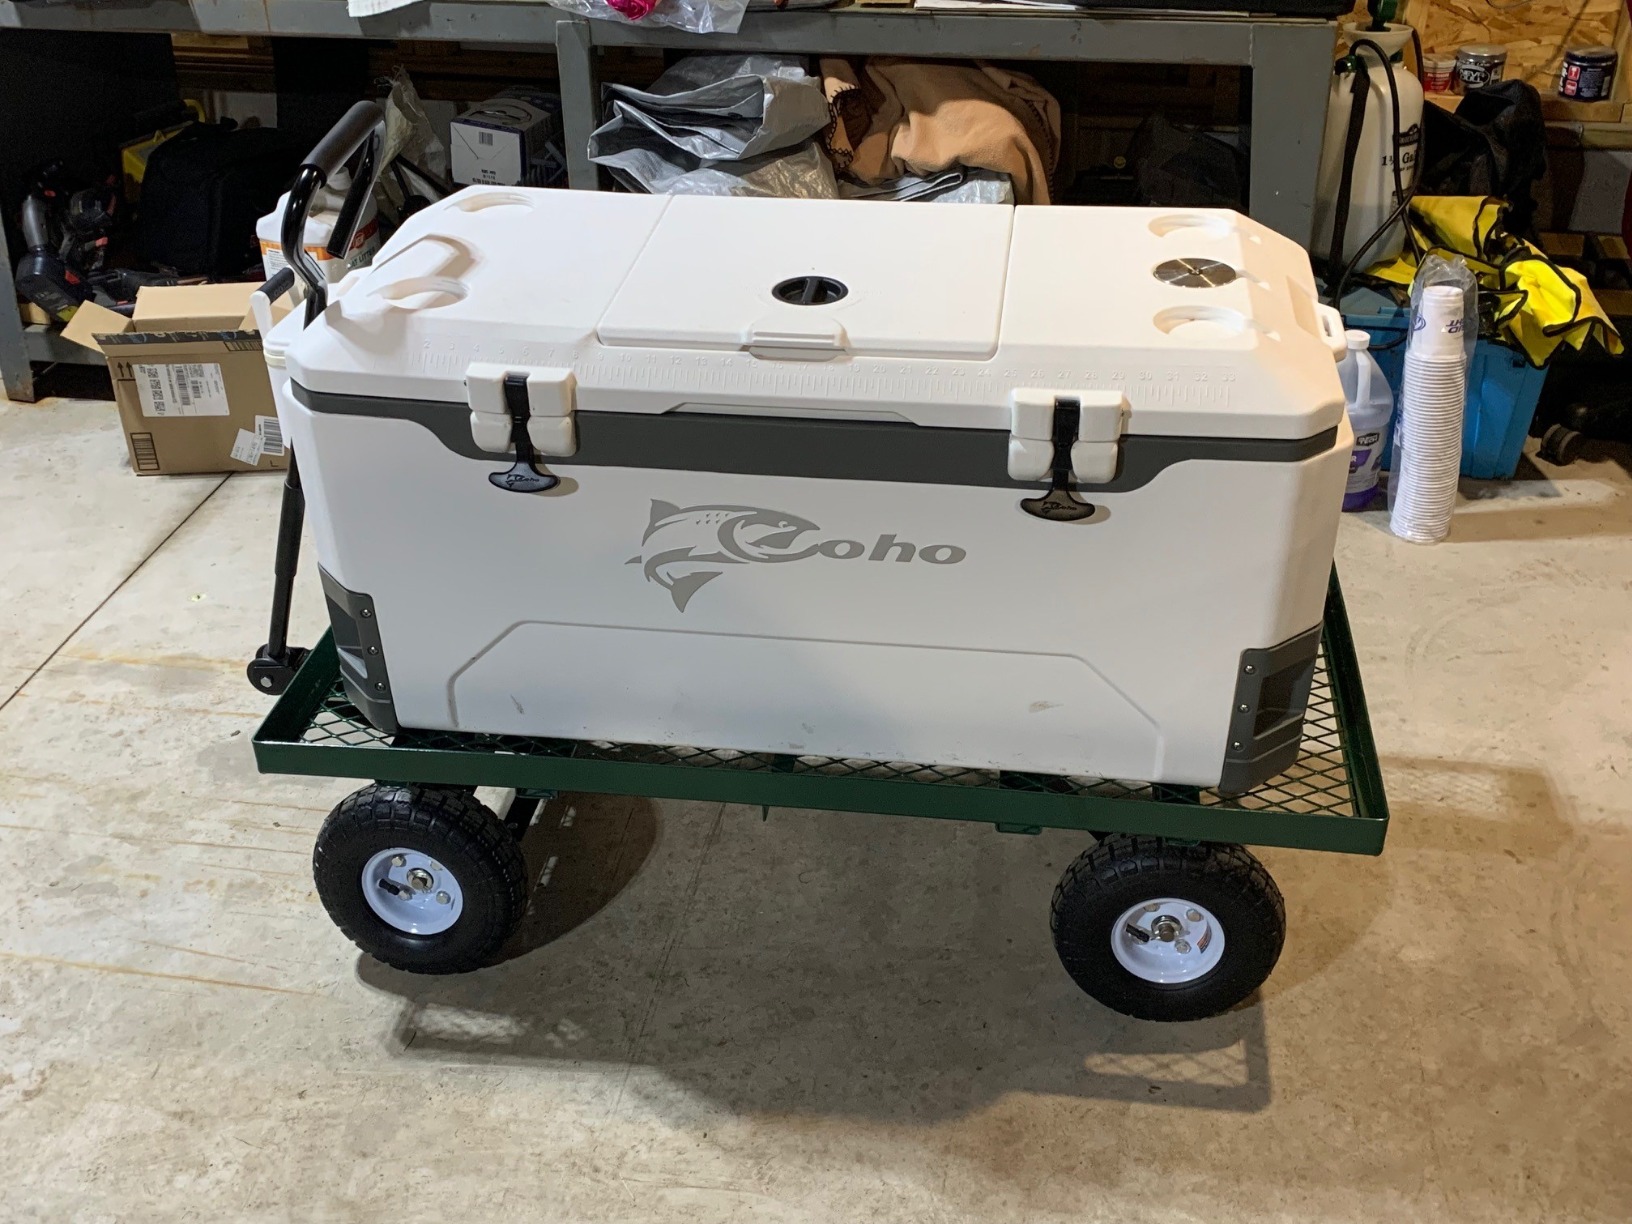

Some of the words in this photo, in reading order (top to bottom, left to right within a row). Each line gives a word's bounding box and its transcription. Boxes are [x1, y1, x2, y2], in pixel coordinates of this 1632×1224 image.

[424, 338, 432, 349] 2
[548, 348, 554, 357] 7
[598, 352, 604, 362] 9
[620, 353, 632, 362] 10
[646, 354, 656, 364] 11
[670, 354, 682, 364] 12
[696, 356, 708, 366] 13
[720, 357, 733, 368] 14
[746, 358, 758, 368] 15
[849, 362, 861, 372] 19
[872, 364, 886, 374] 20
[900, 365, 912, 374] 21
[926, 366, 939, 376] 22
[952, 366, 966, 376] 23
[978, 368, 992, 377] 24
[1004, 368, 1017, 378] 25
[1031, 369, 1045, 378] 26
[1058, 369, 1072, 379] 27
[1084, 370, 1098, 380] 28
[1112, 370, 1126, 381] 29
[1138, 371, 1153, 382] 30
[1168, 371, 1180, 382] 31
[1195, 372, 1208, 382] 32
[1223, 372, 1236, 382] 33
